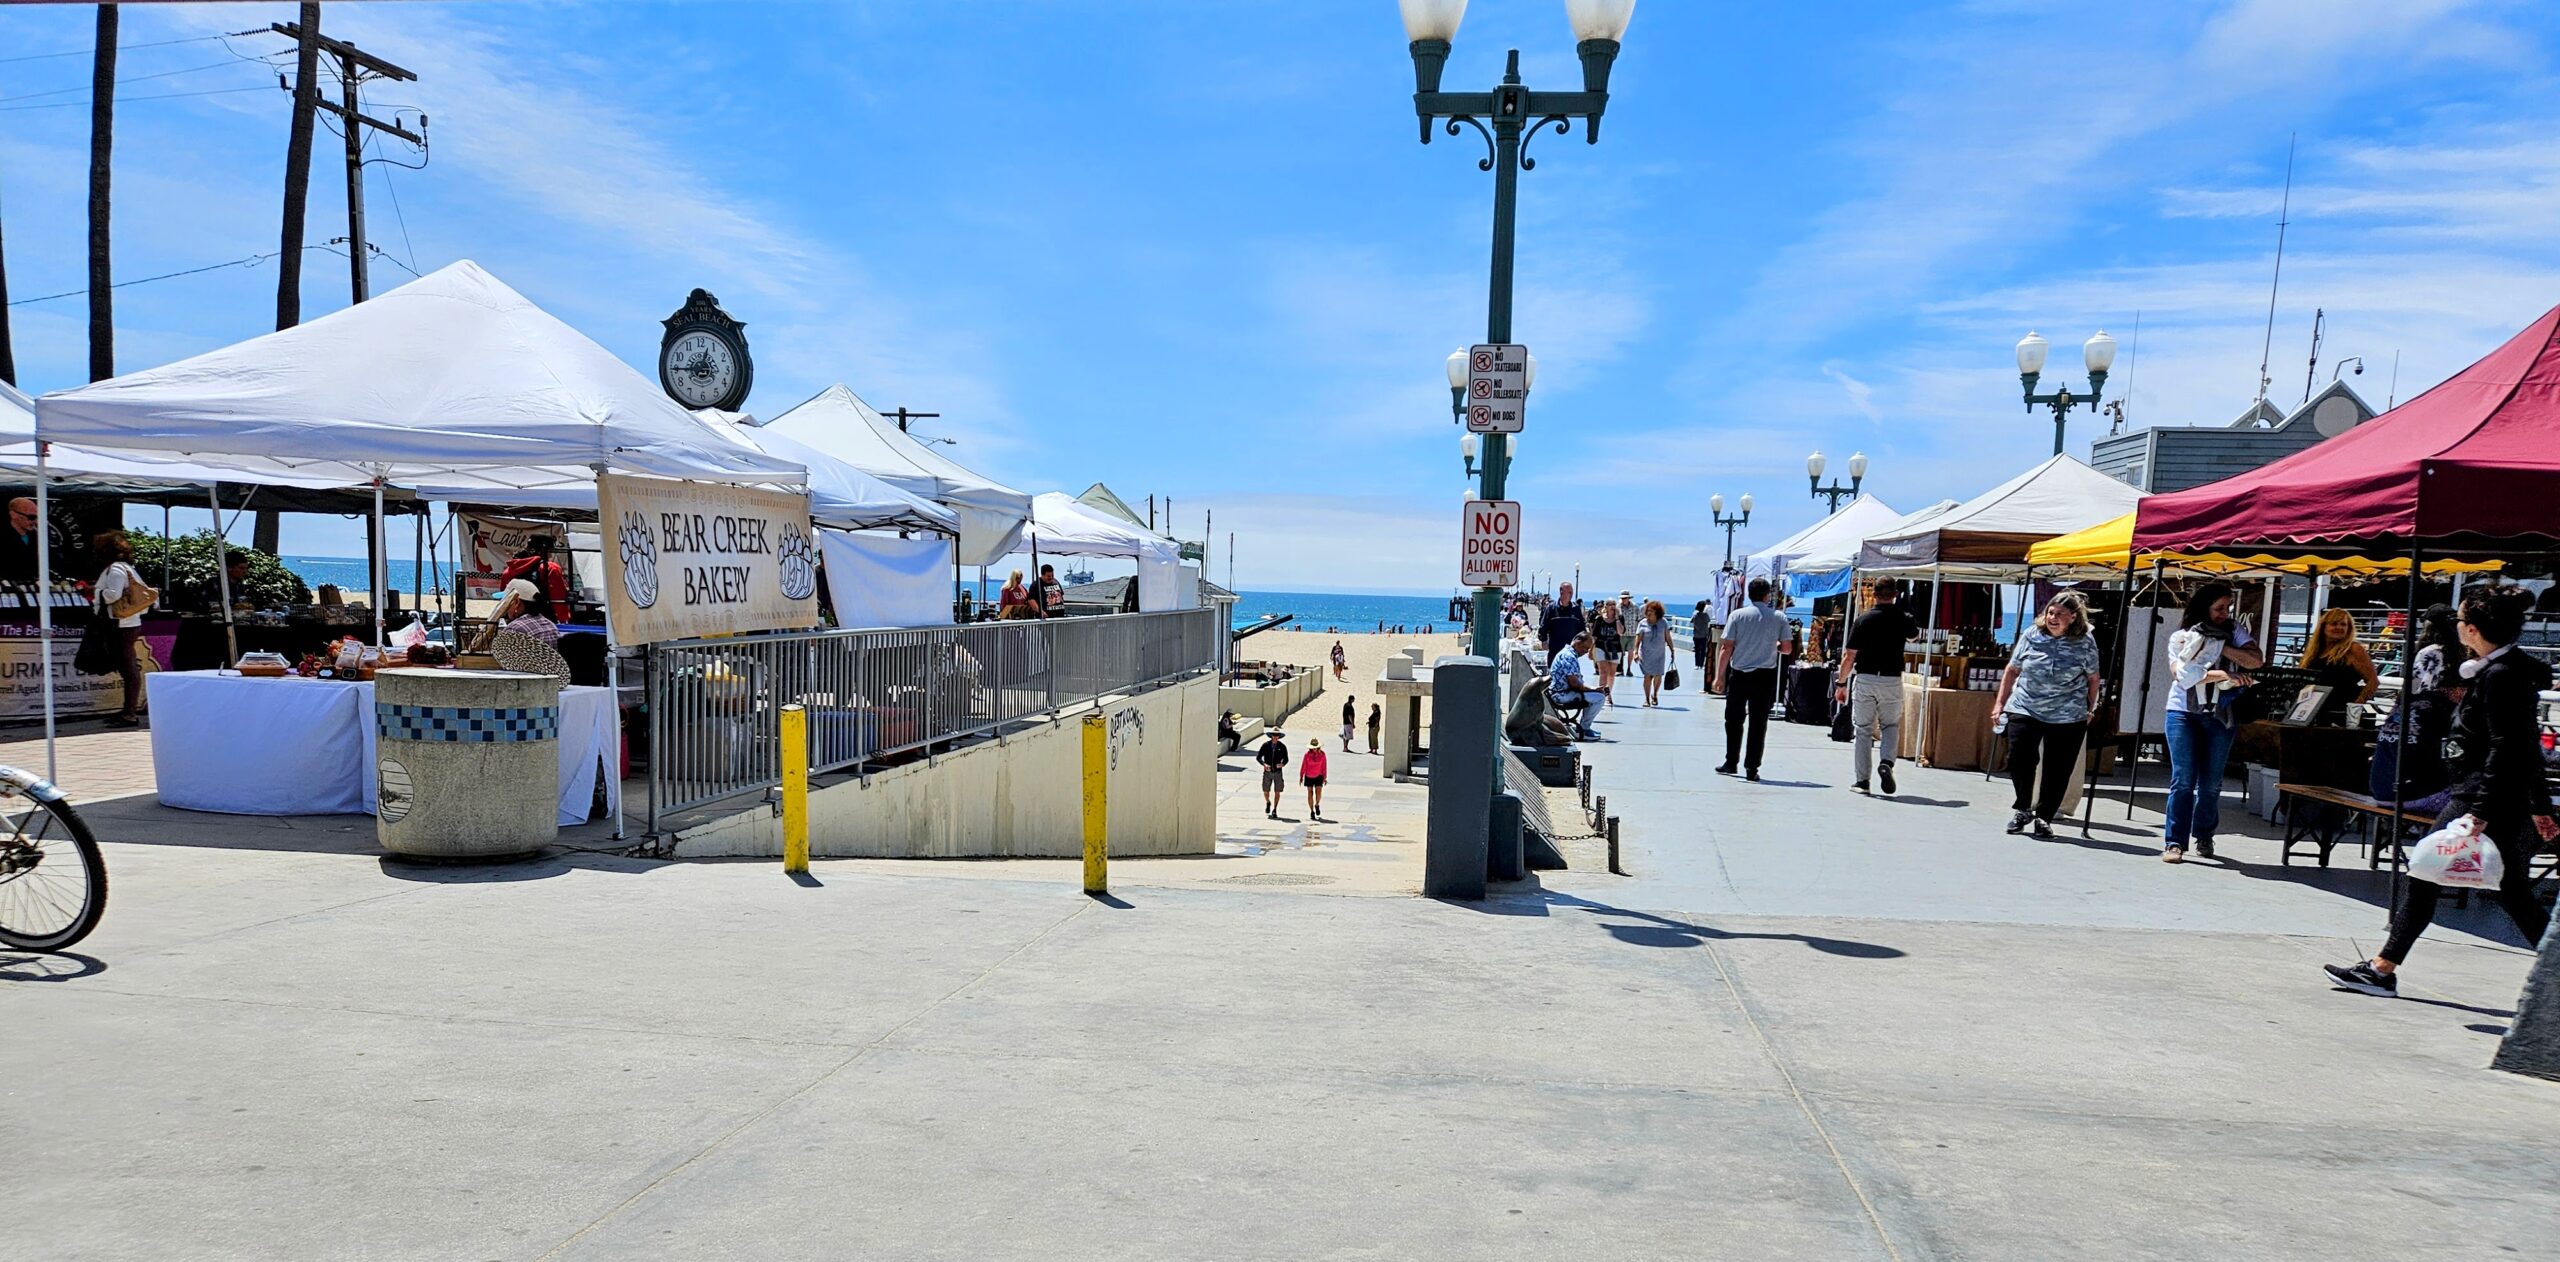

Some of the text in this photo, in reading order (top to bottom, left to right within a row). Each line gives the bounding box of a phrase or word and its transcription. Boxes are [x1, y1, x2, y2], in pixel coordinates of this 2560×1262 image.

[672, 313, 730, 329] SEAL BEACH
[685, 341, 692, 351] 11
[697, 337, 705, 348] 12
[712, 342, 716, 352] 1
[675, 351, 684, 362] 10
[690, 353, 713, 362] LIOS
[720, 352, 726, 362] 2
[1494, 351, 1504, 361] NO
[725, 365, 730, 375] 3
[677, 376, 684, 387] 8
[721, 377, 727, 388] 4
[1493, 378, 1503, 389] NO
[686, 387, 692, 400] 7
[700, 391, 706, 401] 6
[713, 387, 720, 398] 5
[1493, 389, 1522, 400] ROLLERSKATE
[1492, 411, 1516, 421] NO DOGS
[1475, 512, 1510, 535] NO
[660, 512, 771, 555] BEAR CREEK
[1468, 538, 1515, 555] DOGS
[1466, 559, 1514, 573] ALLOWED
[684, 566, 750, 606] BAKERY
[1012, 591, 1026, 600] USA
[16, 684, 41, 697] Aged
